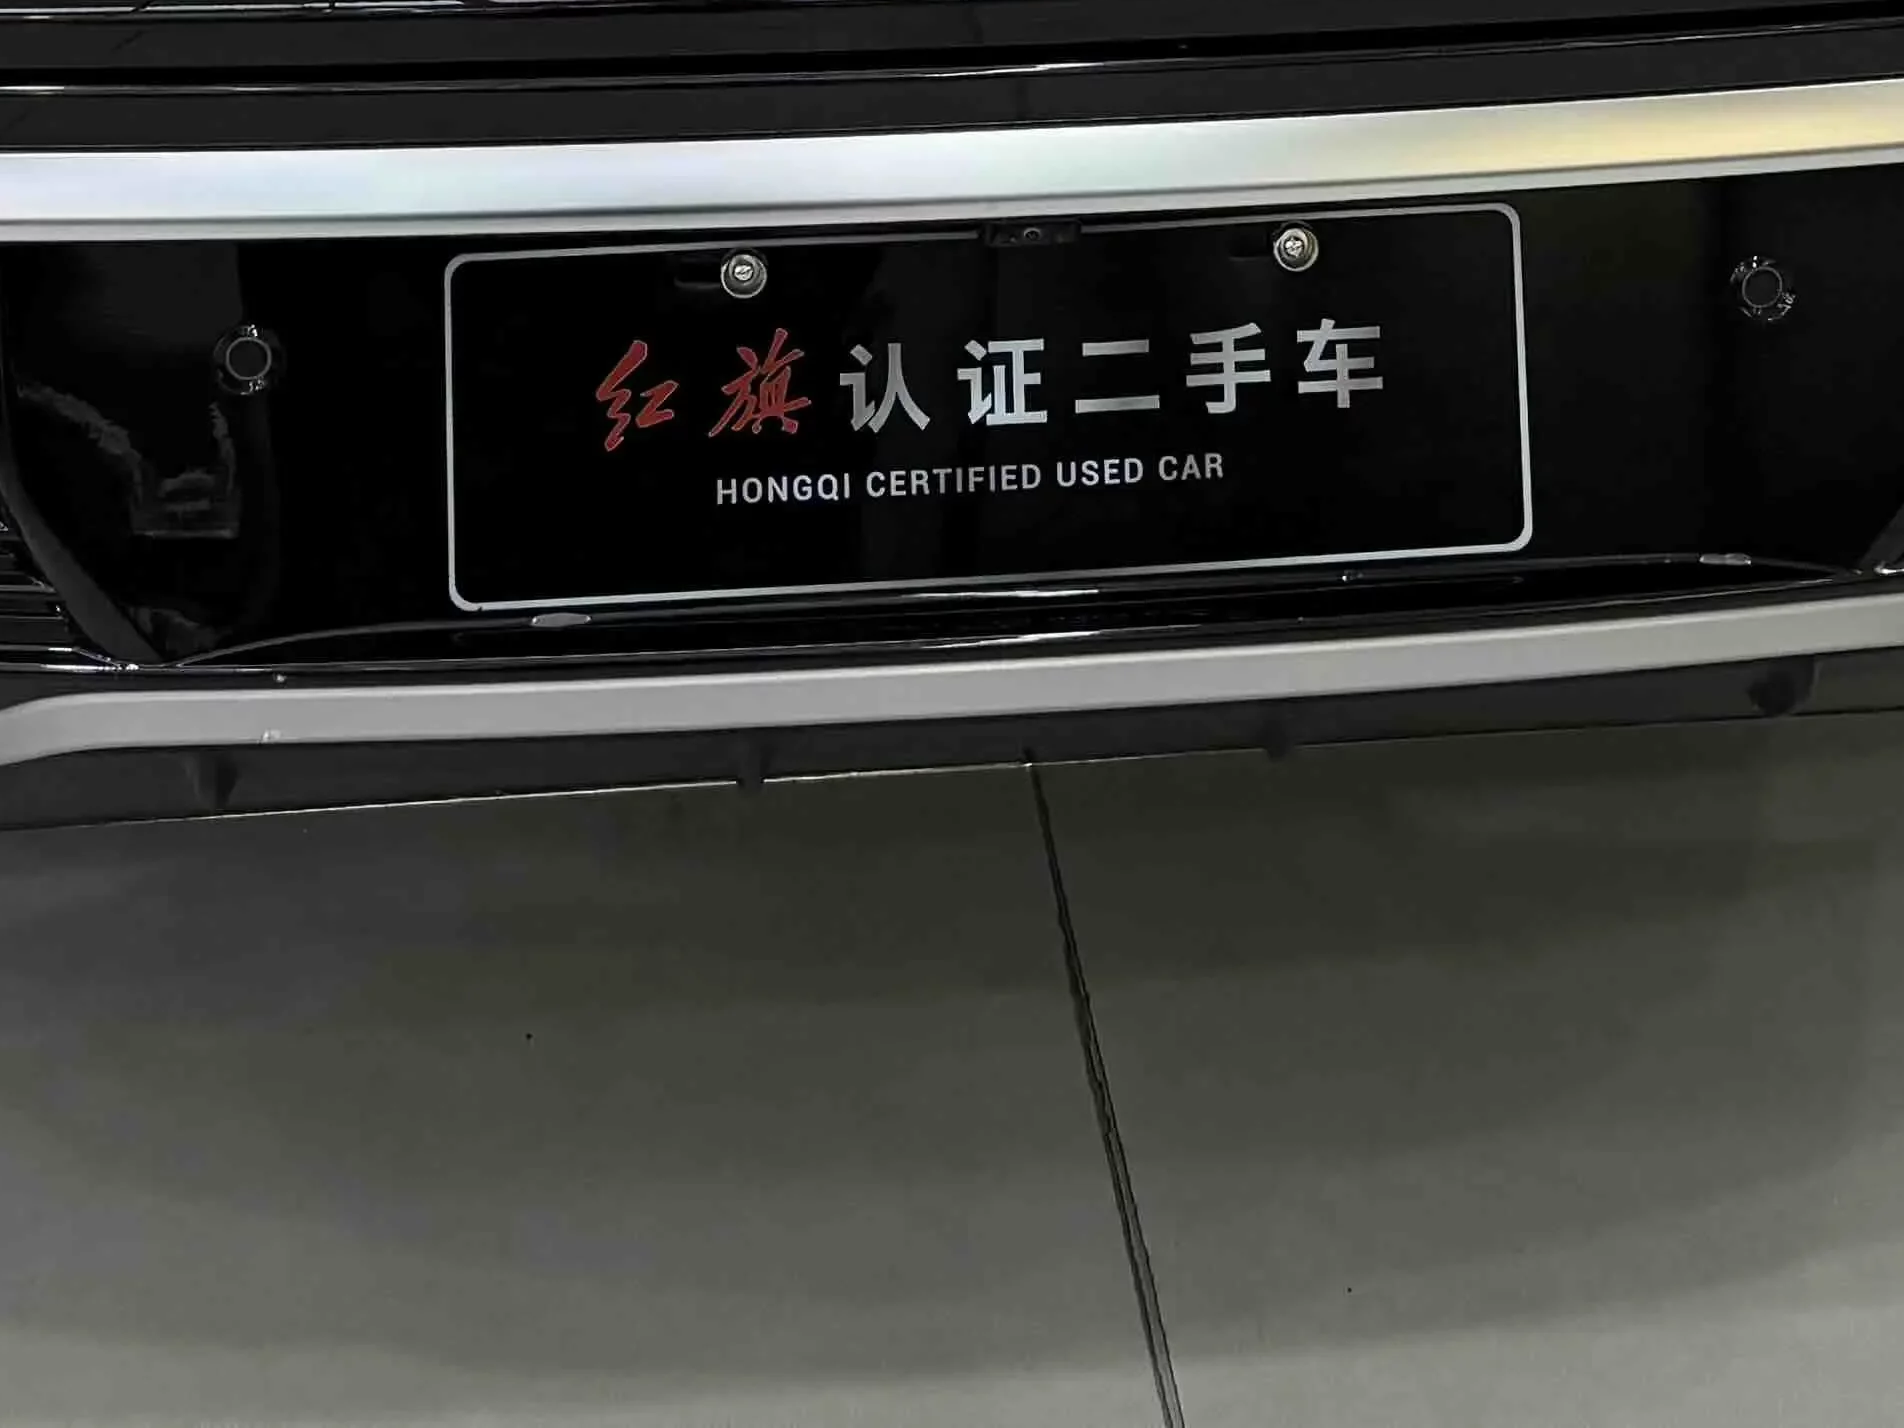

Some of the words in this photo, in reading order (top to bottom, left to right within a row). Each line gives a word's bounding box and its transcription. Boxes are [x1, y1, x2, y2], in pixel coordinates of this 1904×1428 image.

[715, 473, 852, 506] HONGQI
[865, 462, 1043, 501] CERTIFIED
[1056, 457, 1145, 489] USED
[1158, 452, 1225, 482] CAR
